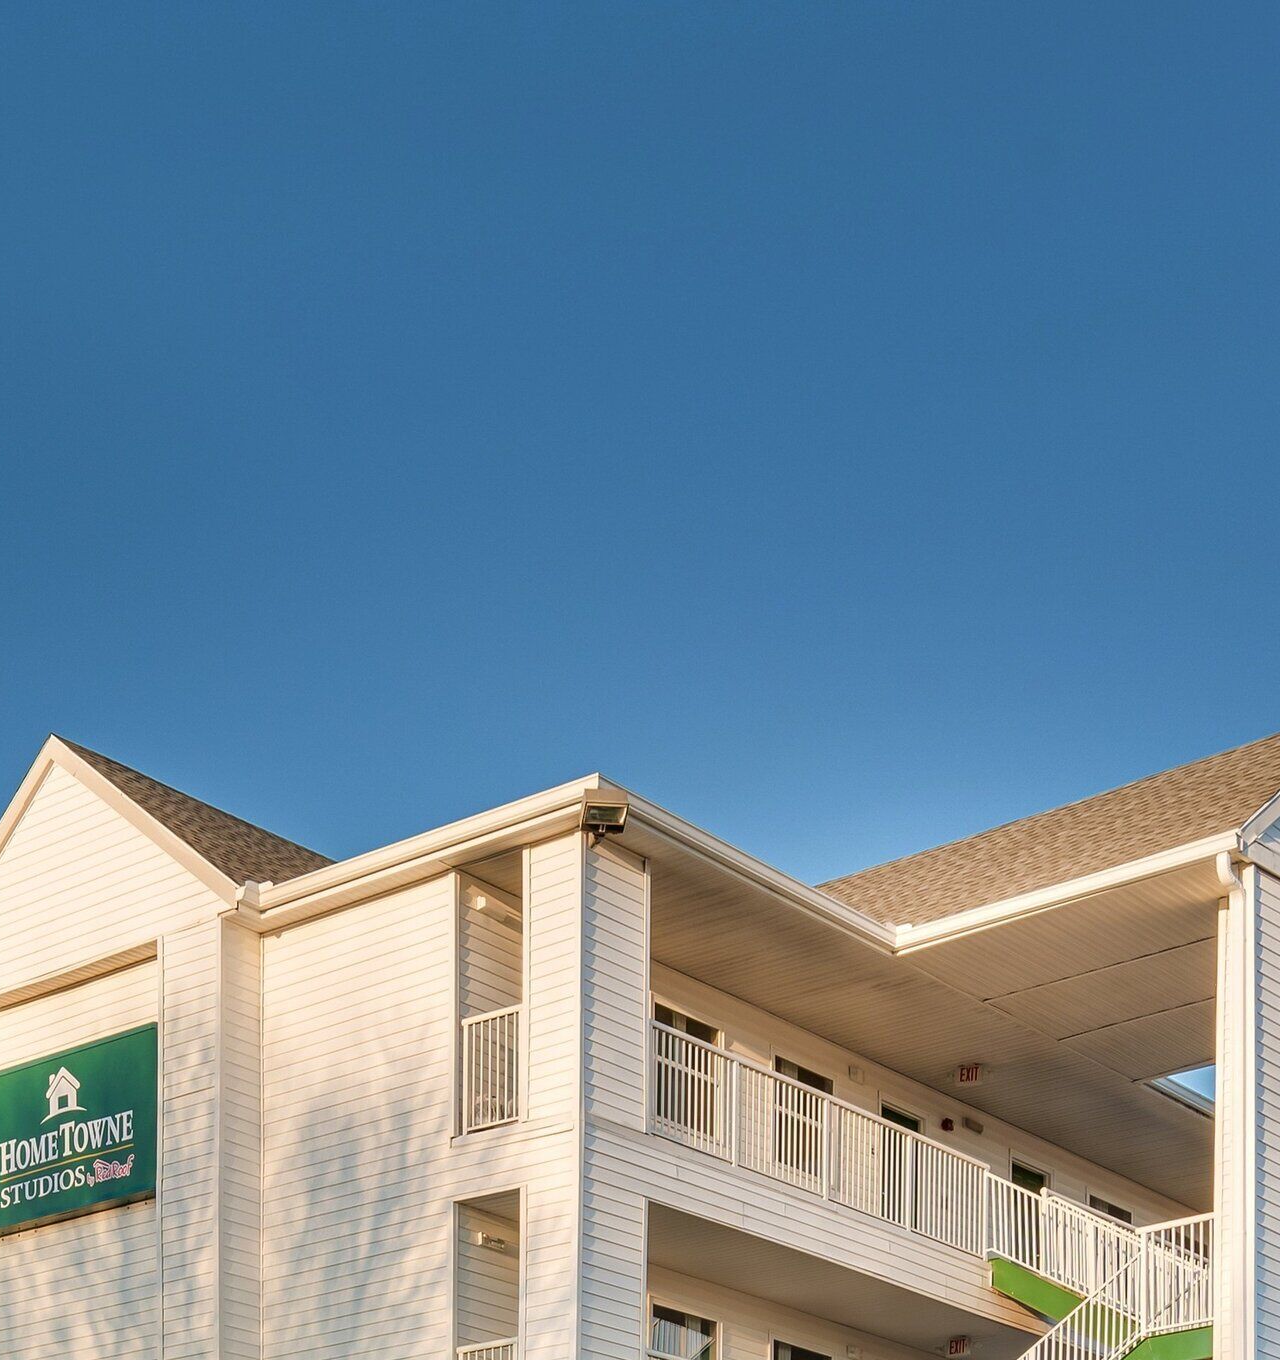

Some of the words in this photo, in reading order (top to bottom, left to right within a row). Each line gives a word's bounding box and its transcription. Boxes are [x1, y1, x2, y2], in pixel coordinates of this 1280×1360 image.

[959, 1066, 980, 1082] EXIT
[0, 1165, 86, 1209] STUDIOS
[949, 1339, 966, 1354] EXIT
